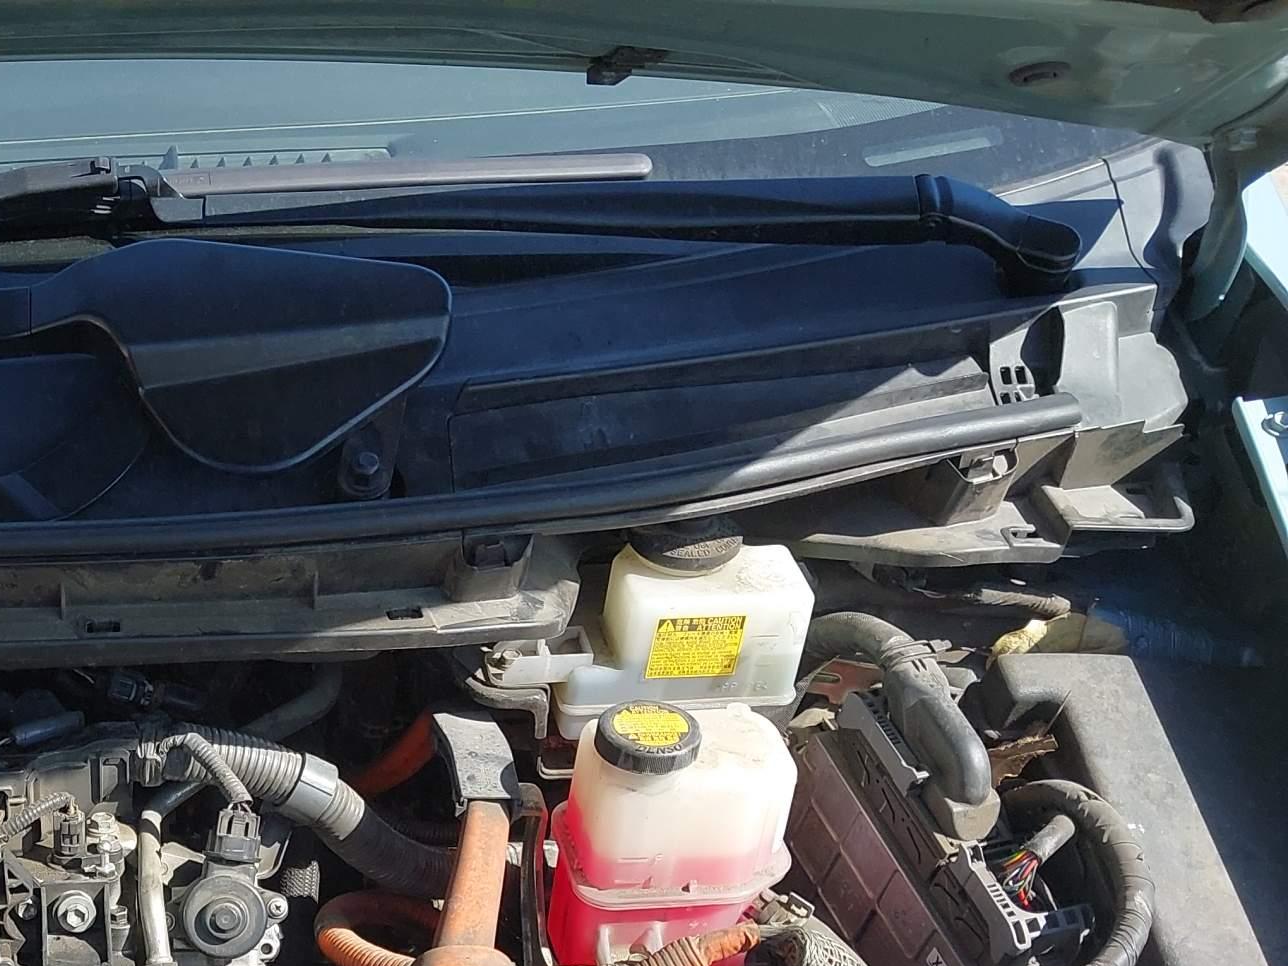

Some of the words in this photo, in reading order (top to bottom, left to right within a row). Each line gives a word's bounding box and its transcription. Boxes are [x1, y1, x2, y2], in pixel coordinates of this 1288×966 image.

[707, 616, 743, 625] CAUTION
[697, 623, 741, 631] ATTENTION
[635, 743, 683, 754] DENSO
